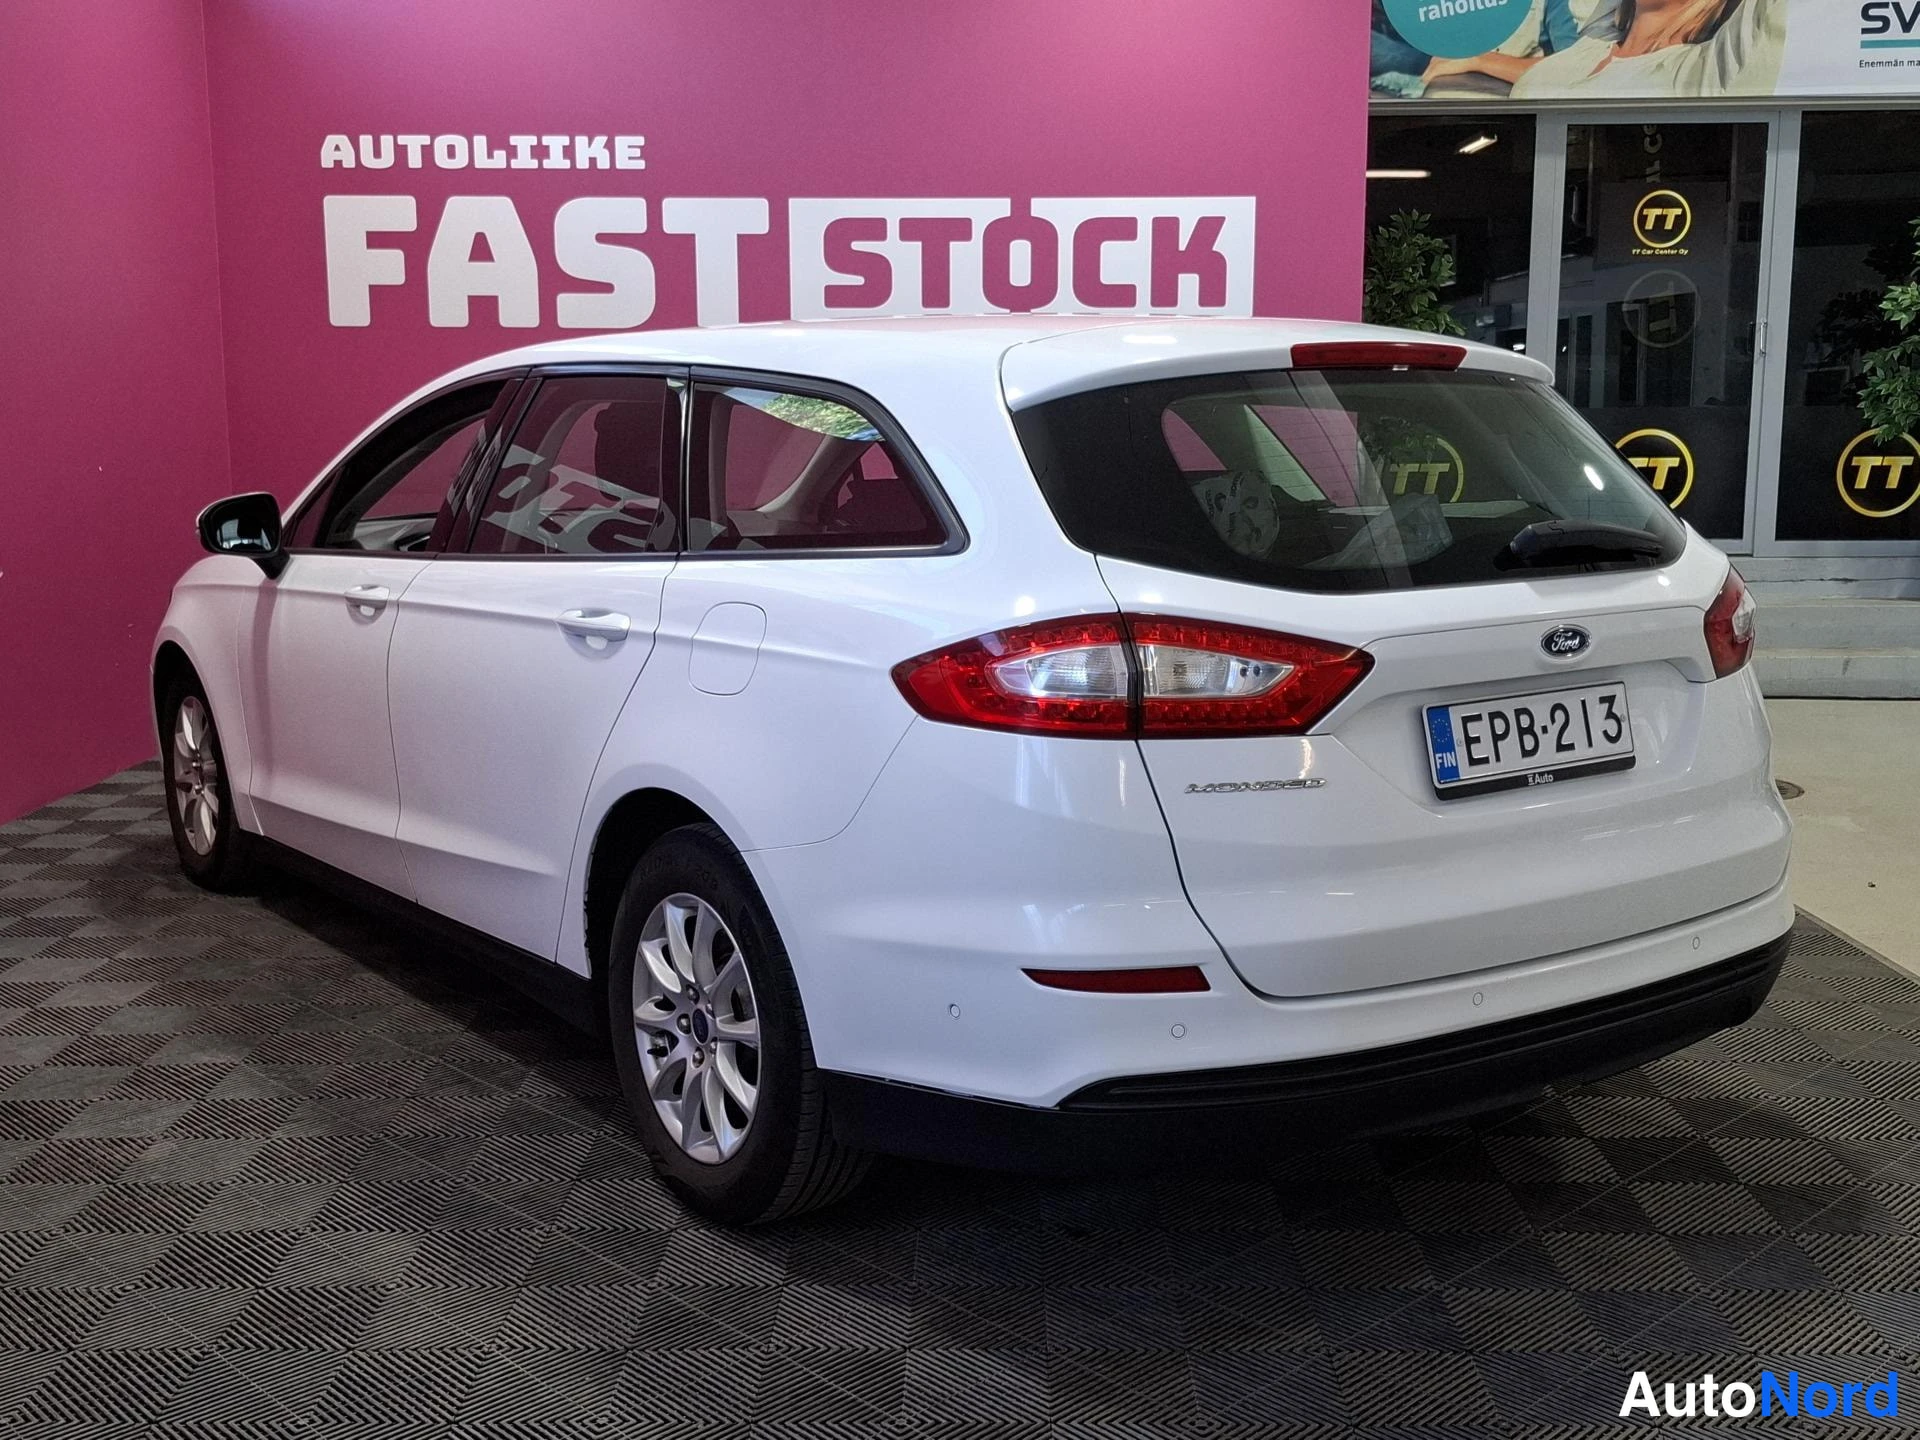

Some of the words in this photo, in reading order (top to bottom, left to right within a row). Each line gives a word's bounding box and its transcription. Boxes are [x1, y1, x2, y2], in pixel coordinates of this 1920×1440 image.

[320, 134, 647, 170] AUTOLIIKE
[1642, 208, 1682, 230] TT
[323, 195, 770, 328] FAST
[822, 214, 1228, 312] STOCK
[1851, 456, 1915, 489] TT
[1551, 632, 1580, 651] Ford
[1460, 694, 1623, 768] EPB-213
[1435, 751, 1458, 770] FIN
